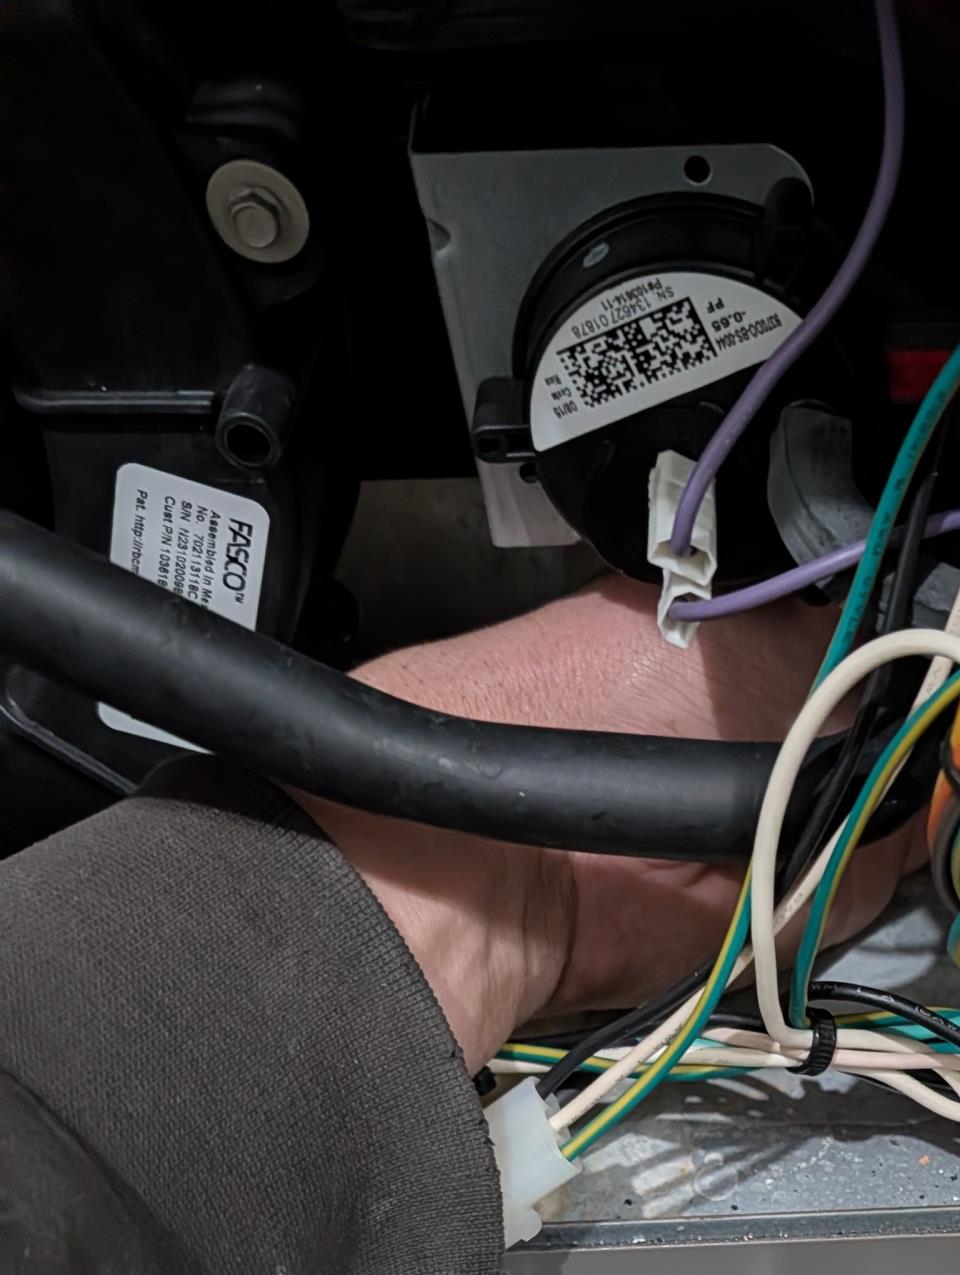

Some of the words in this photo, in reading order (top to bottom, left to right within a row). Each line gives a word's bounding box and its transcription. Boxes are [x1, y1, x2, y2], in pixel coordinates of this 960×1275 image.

[163, 495, 176, 524] Cust
[180, 501, 193, 522] S/N
[196, 505, 209, 524] No.
[161, 525, 173, 546] P/N
[204, 510, 221, 575] Assembled
